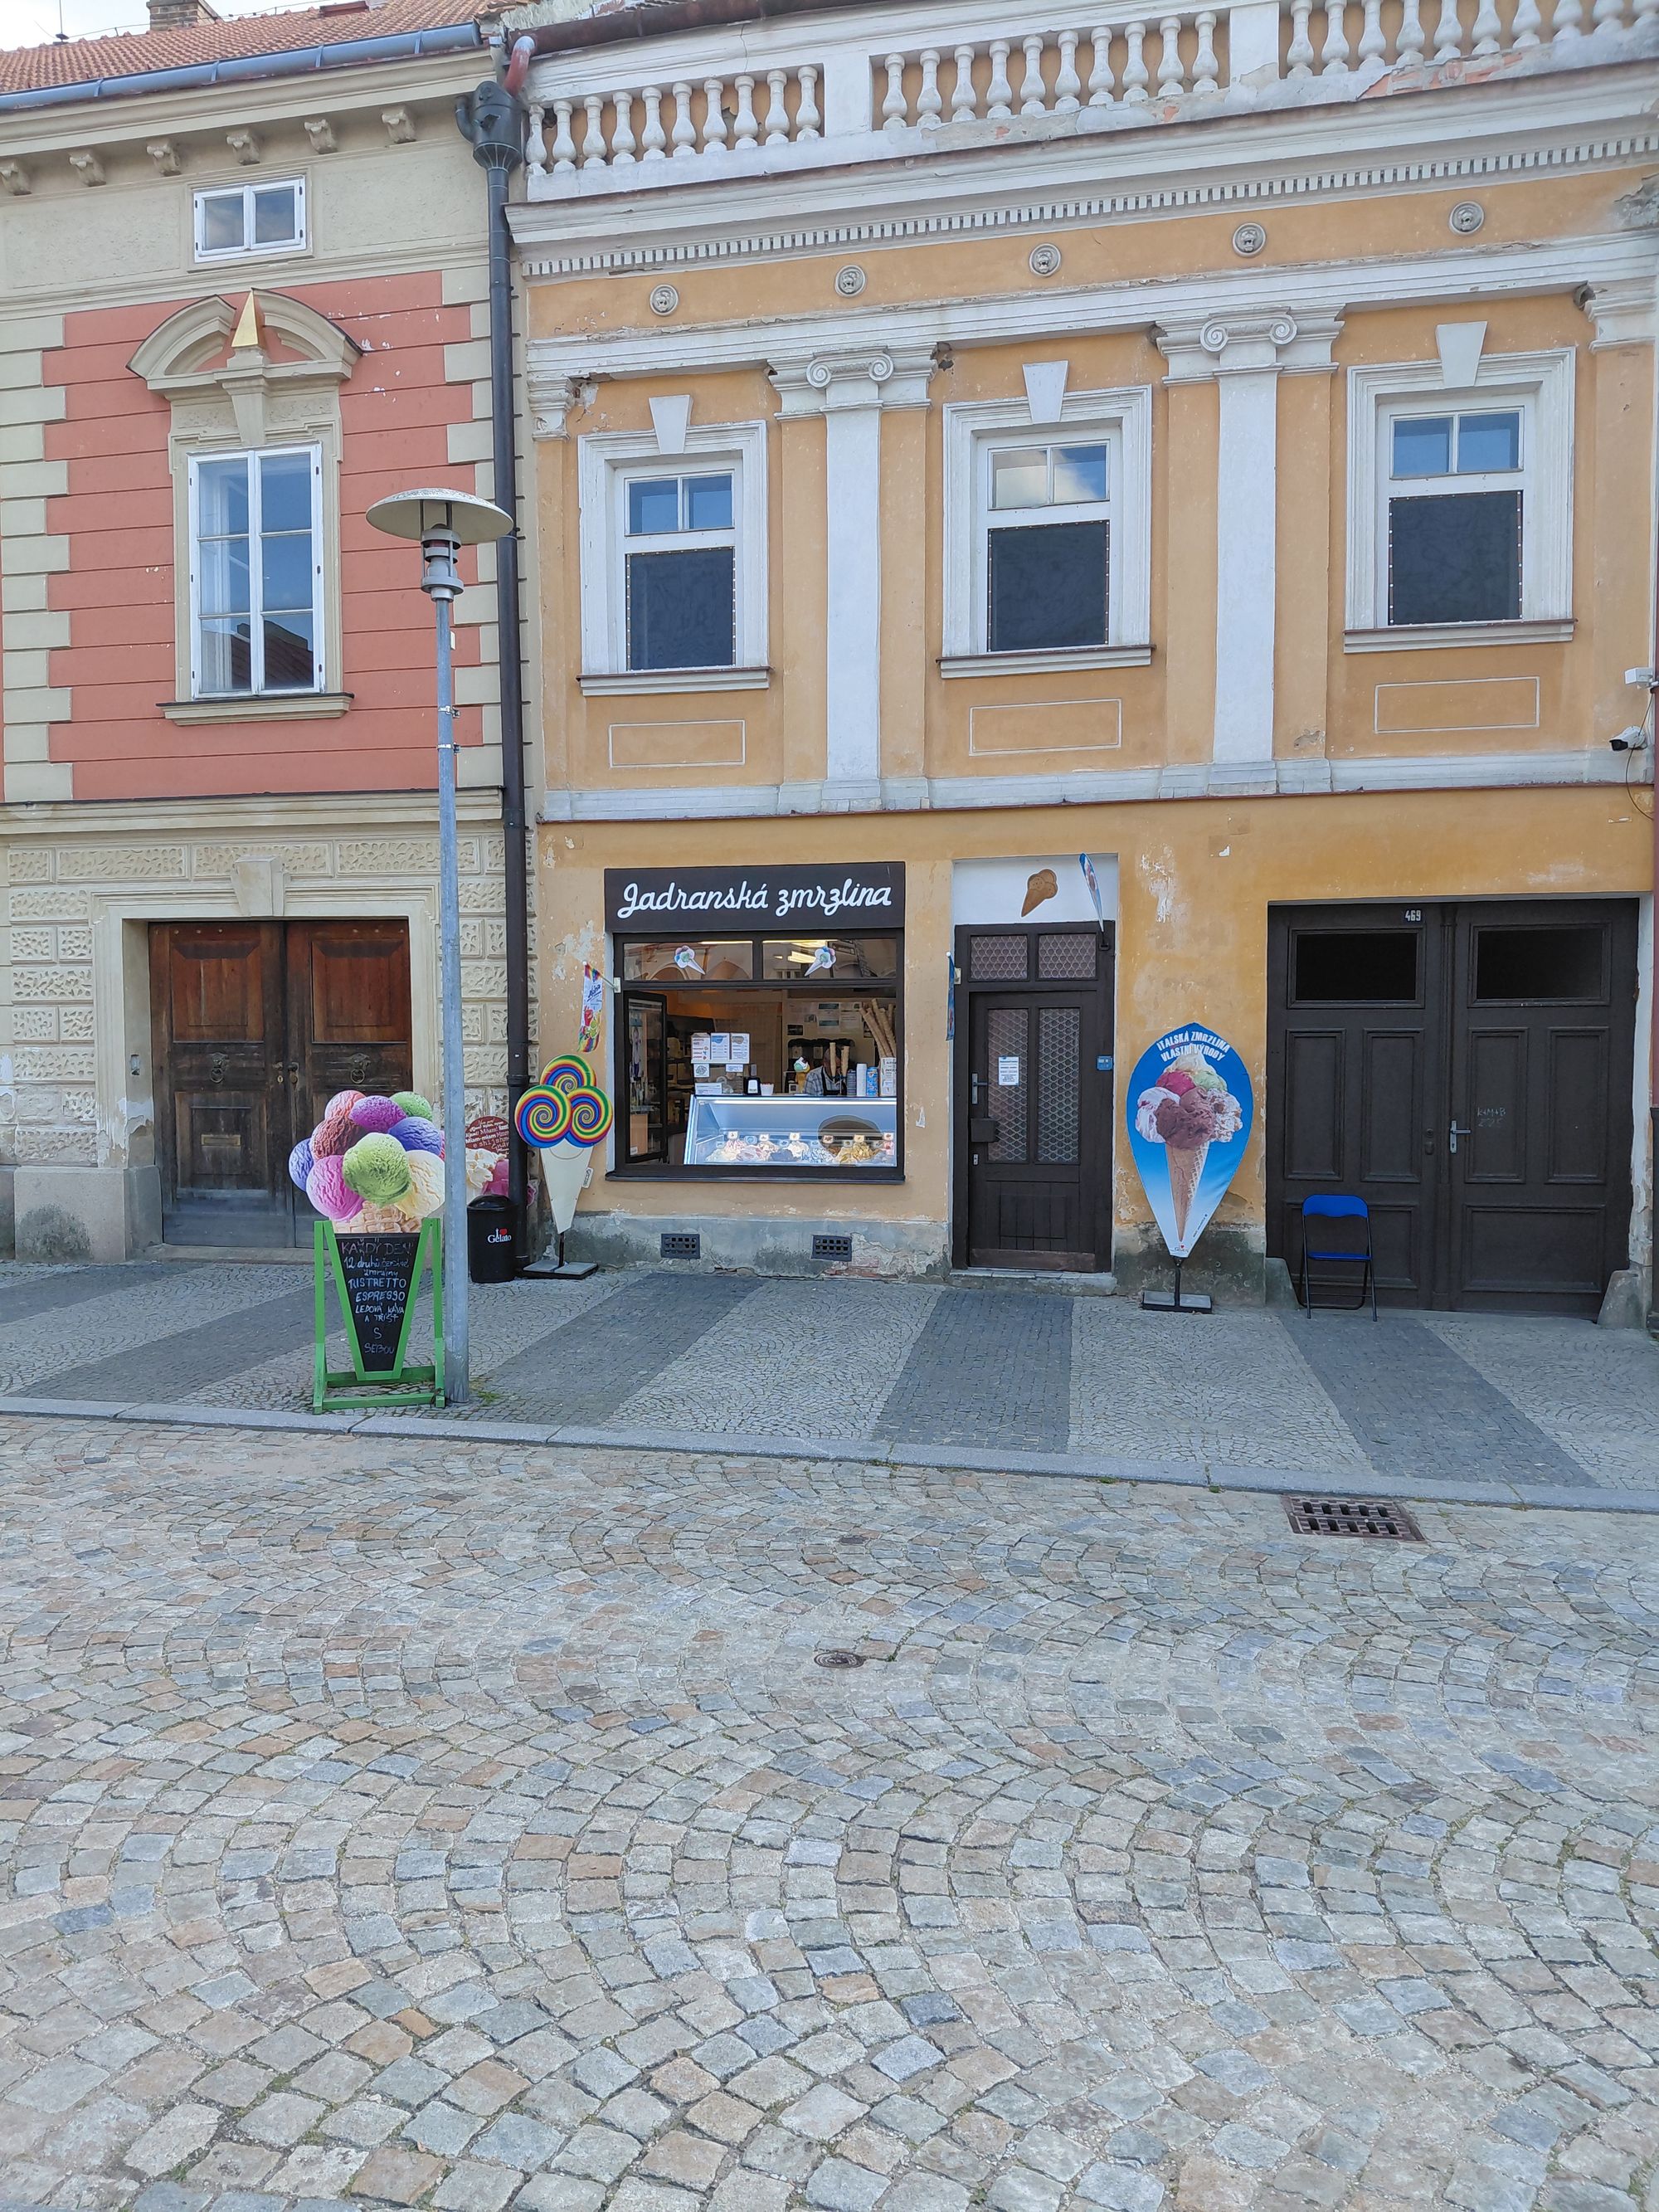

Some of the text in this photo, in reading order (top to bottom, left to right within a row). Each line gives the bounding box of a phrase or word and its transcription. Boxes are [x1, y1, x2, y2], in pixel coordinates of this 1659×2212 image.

[617, 878, 892, 918] Jadranská zmrzlina
[1404, 909, 1421, 922] 469
[1156, 1030, 1231, 1054] ITALSKÁ ZMRZLINA
[1160, 1043, 1193, 1063] VLASTNÍ
[488, 1233, 512, 1244] Gelato
[344, 1256, 356, 1269] 12
[348, 1277, 407, 1290] RISTRETTO
[355, 1290, 406, 1303] ESPRESSO
[373, 1327, 382, 1340] S
[364, 1342, 395, 1355] SEBOU
